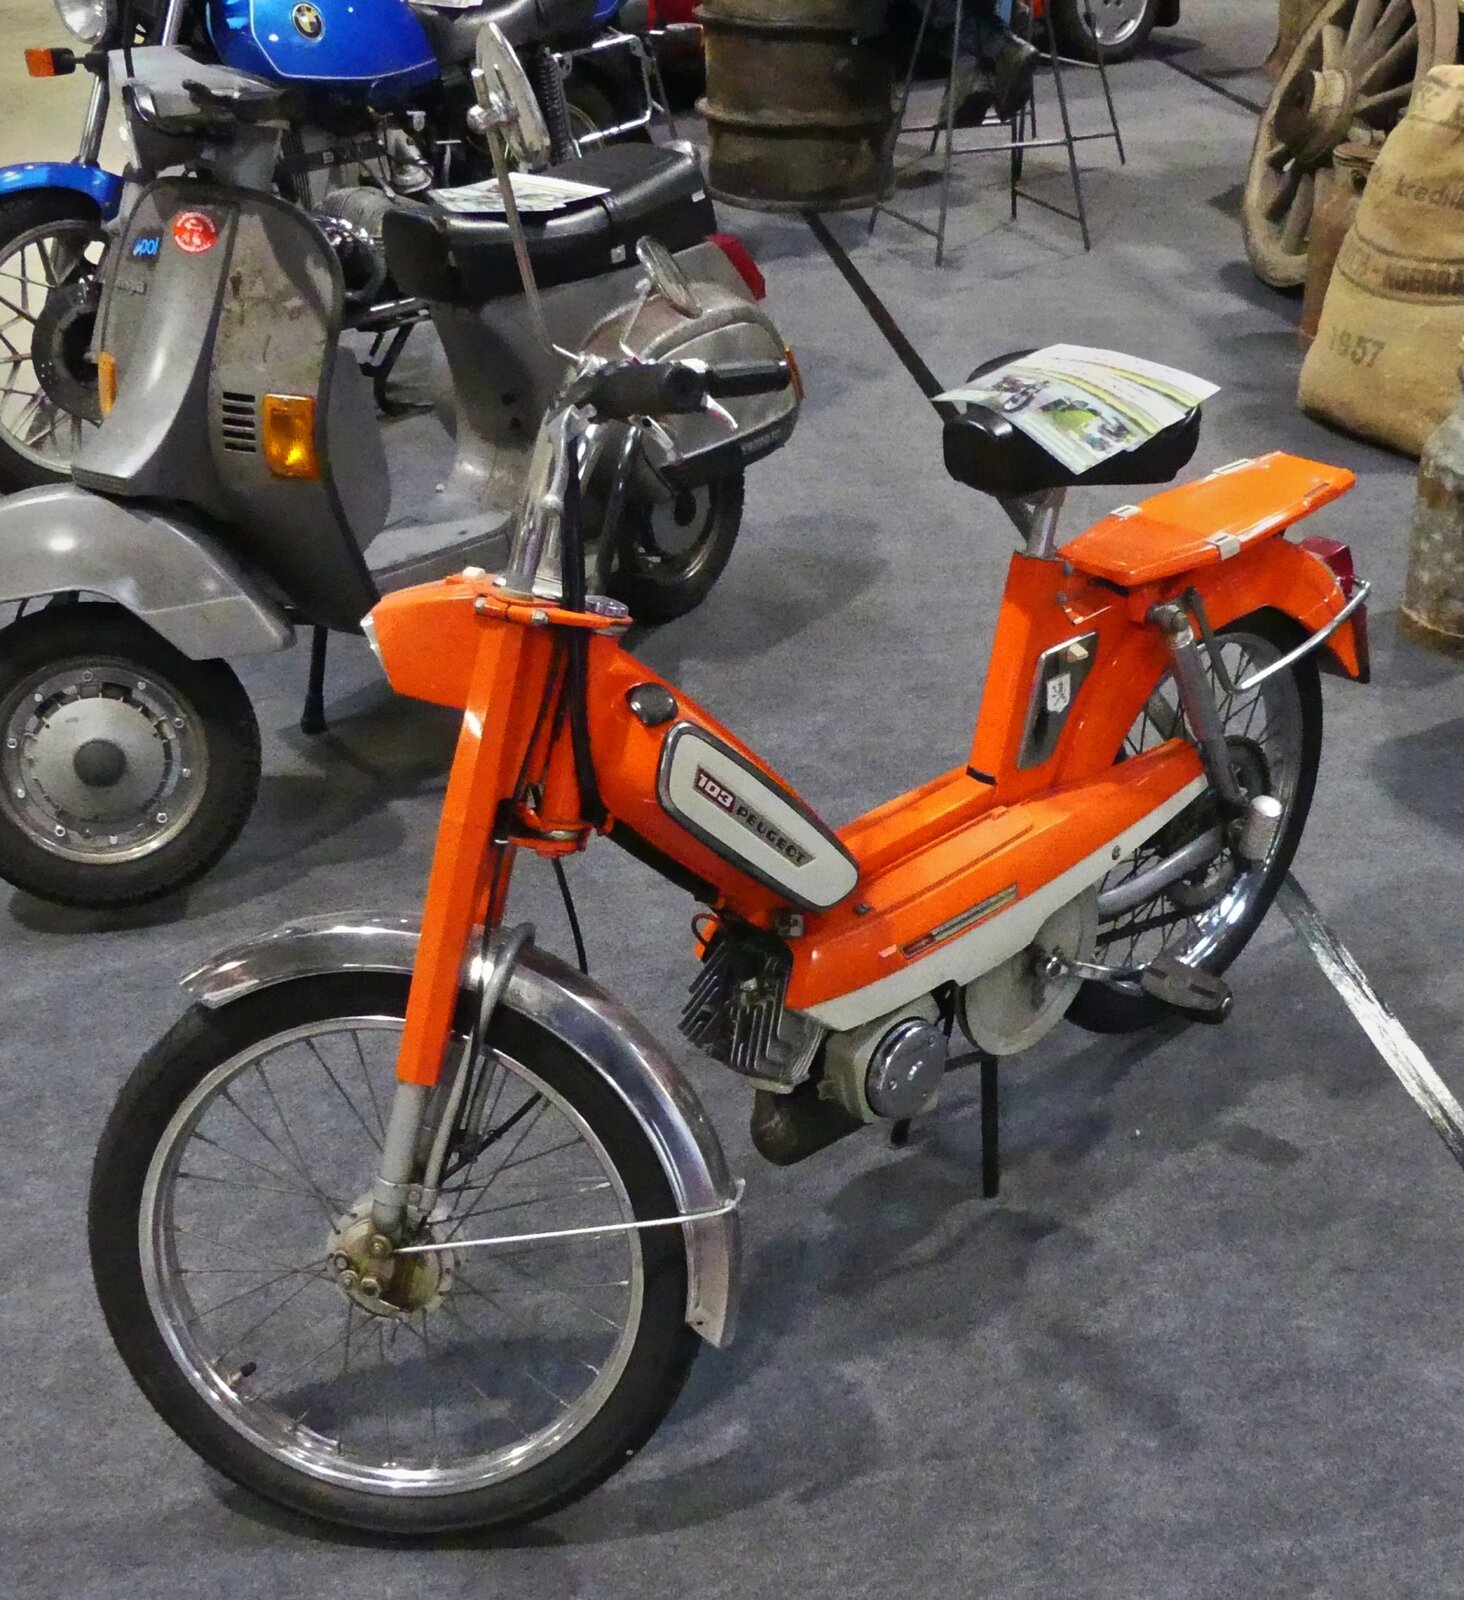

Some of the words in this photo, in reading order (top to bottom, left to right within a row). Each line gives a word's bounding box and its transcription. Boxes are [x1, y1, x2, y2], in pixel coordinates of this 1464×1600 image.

[1328, 327, 1386, 368] 1957
[698, 773, 734, 808] 103
[736, 806, 806, 863] PEUGEOT
